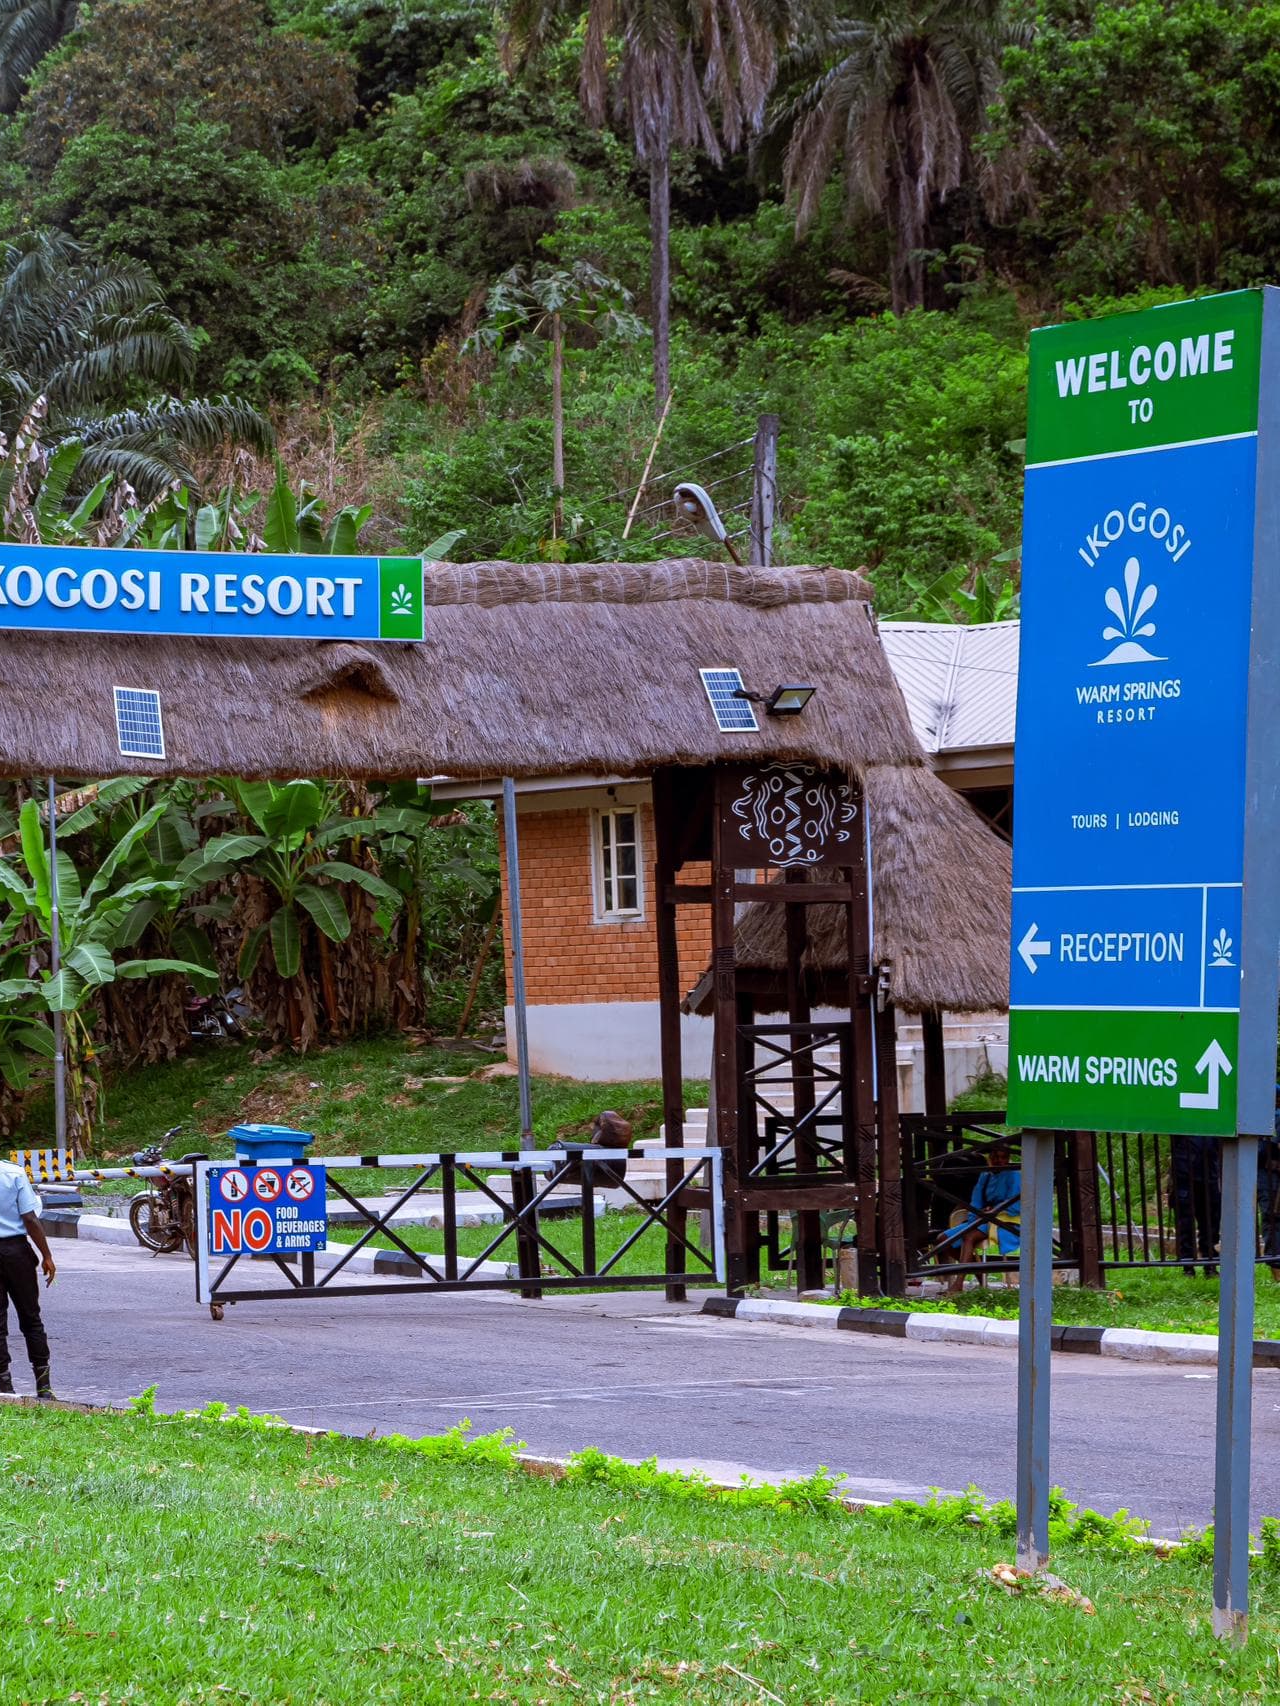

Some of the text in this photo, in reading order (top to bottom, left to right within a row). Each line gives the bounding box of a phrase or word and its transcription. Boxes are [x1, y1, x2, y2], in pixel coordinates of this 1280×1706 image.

[1055, 329, 1235, 398] WELCOME
[1128, 397, 1154, 424] TO
[1078, 501, 1192, 568] IKOGOSI
[180, 571, 363, 617] RESORT
[1076, 679, 1181, 705] WARM SPRINGS
[1097, 706, 1156, 724] RESORT
[1071, 813, 1108, 829] TOURS
[1128, 810, 1180, 827] LODGING
[1059, 932, 1184, 962] RECEPTION
[1017, 1054, 1178, 1087] WARM SPRINGS
[276, 1206, 298, 1219] FOOD
[212, 1207, 273, 1252] NO
[276, 1220, 325, 1234] BEVERAGES
[276, 1235, 311, 1248] & ARMS
